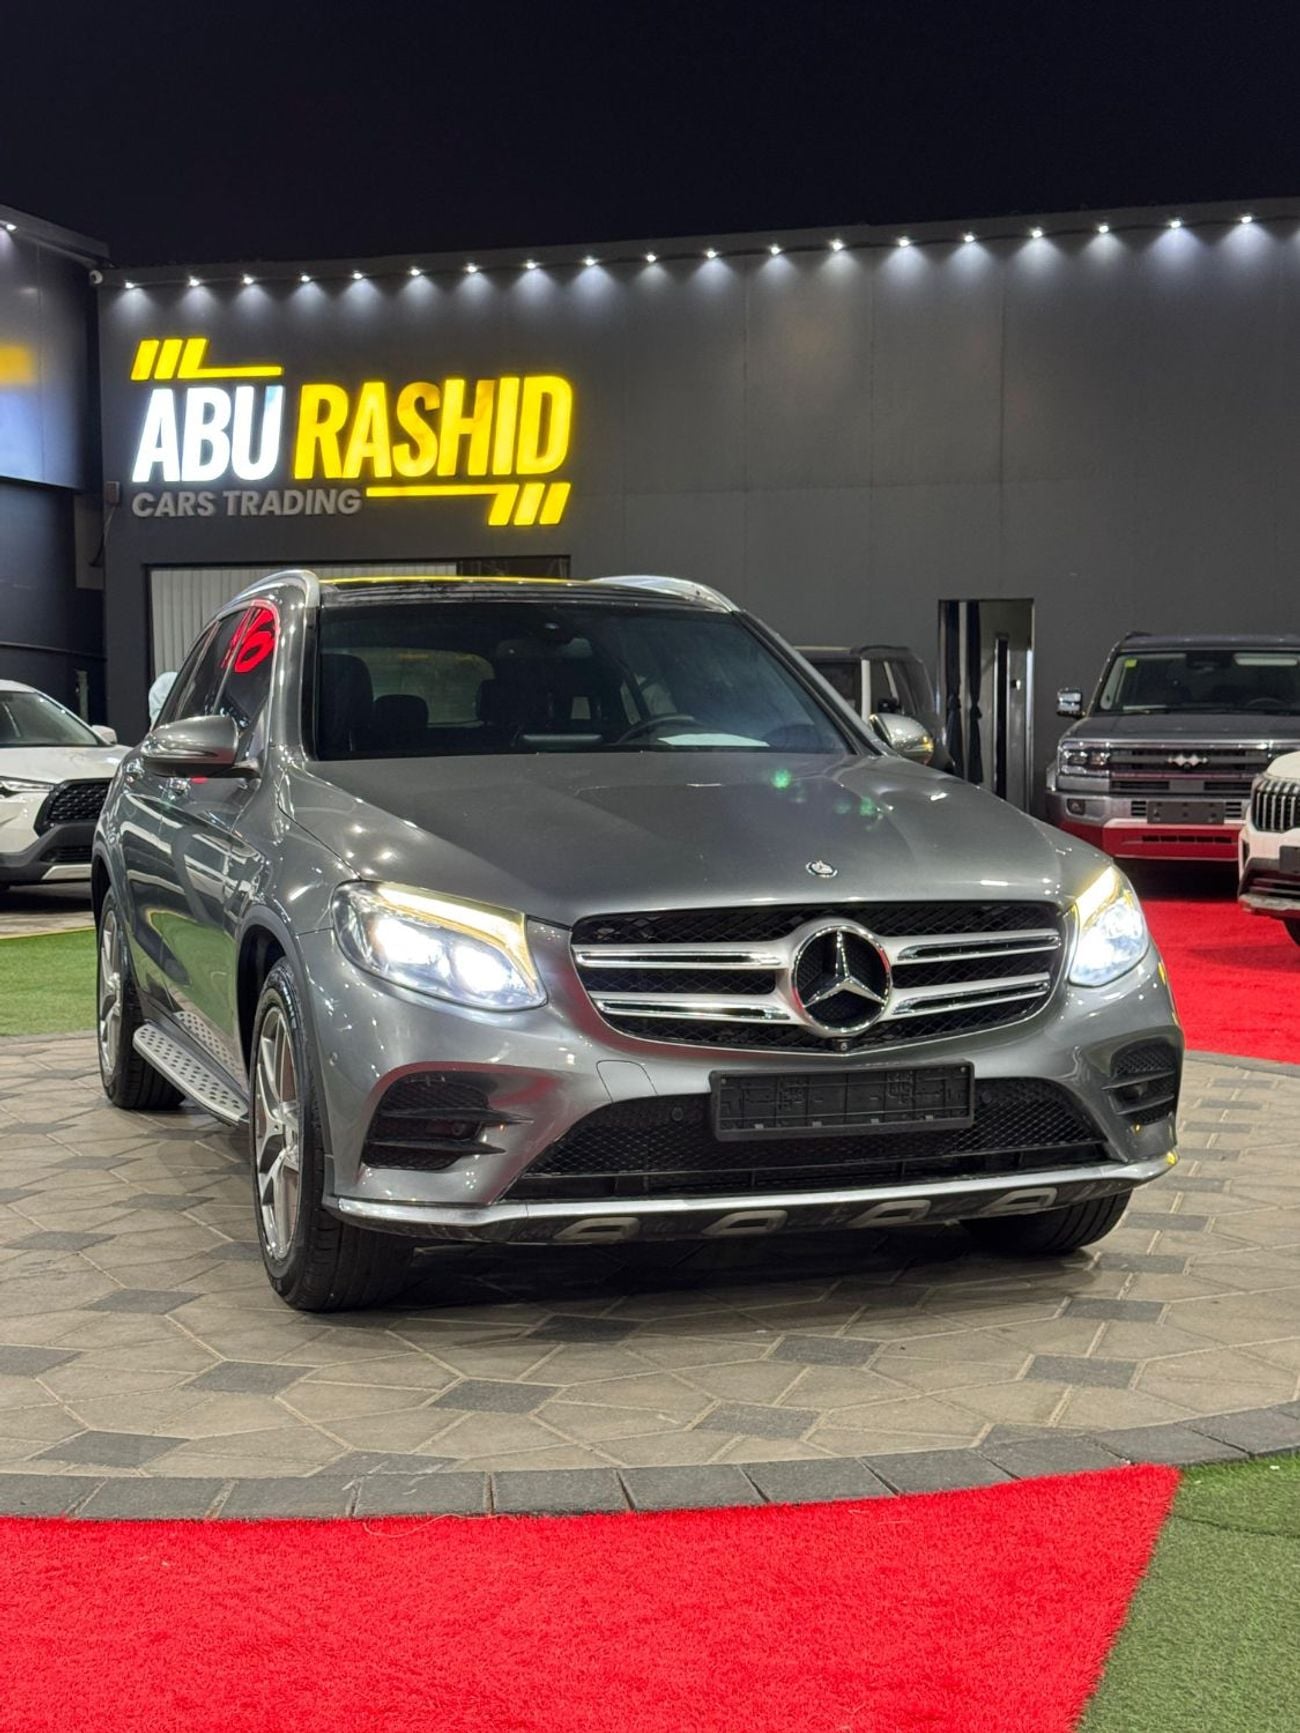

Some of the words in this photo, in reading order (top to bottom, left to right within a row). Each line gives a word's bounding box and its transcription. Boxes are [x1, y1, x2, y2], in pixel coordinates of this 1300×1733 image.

[131, 386, 285, 484] ABU
[293, 375, 573, 479] RASHID
[131, 490, 215, 518] CARS
[223, 489, 362, 517] TRADING
